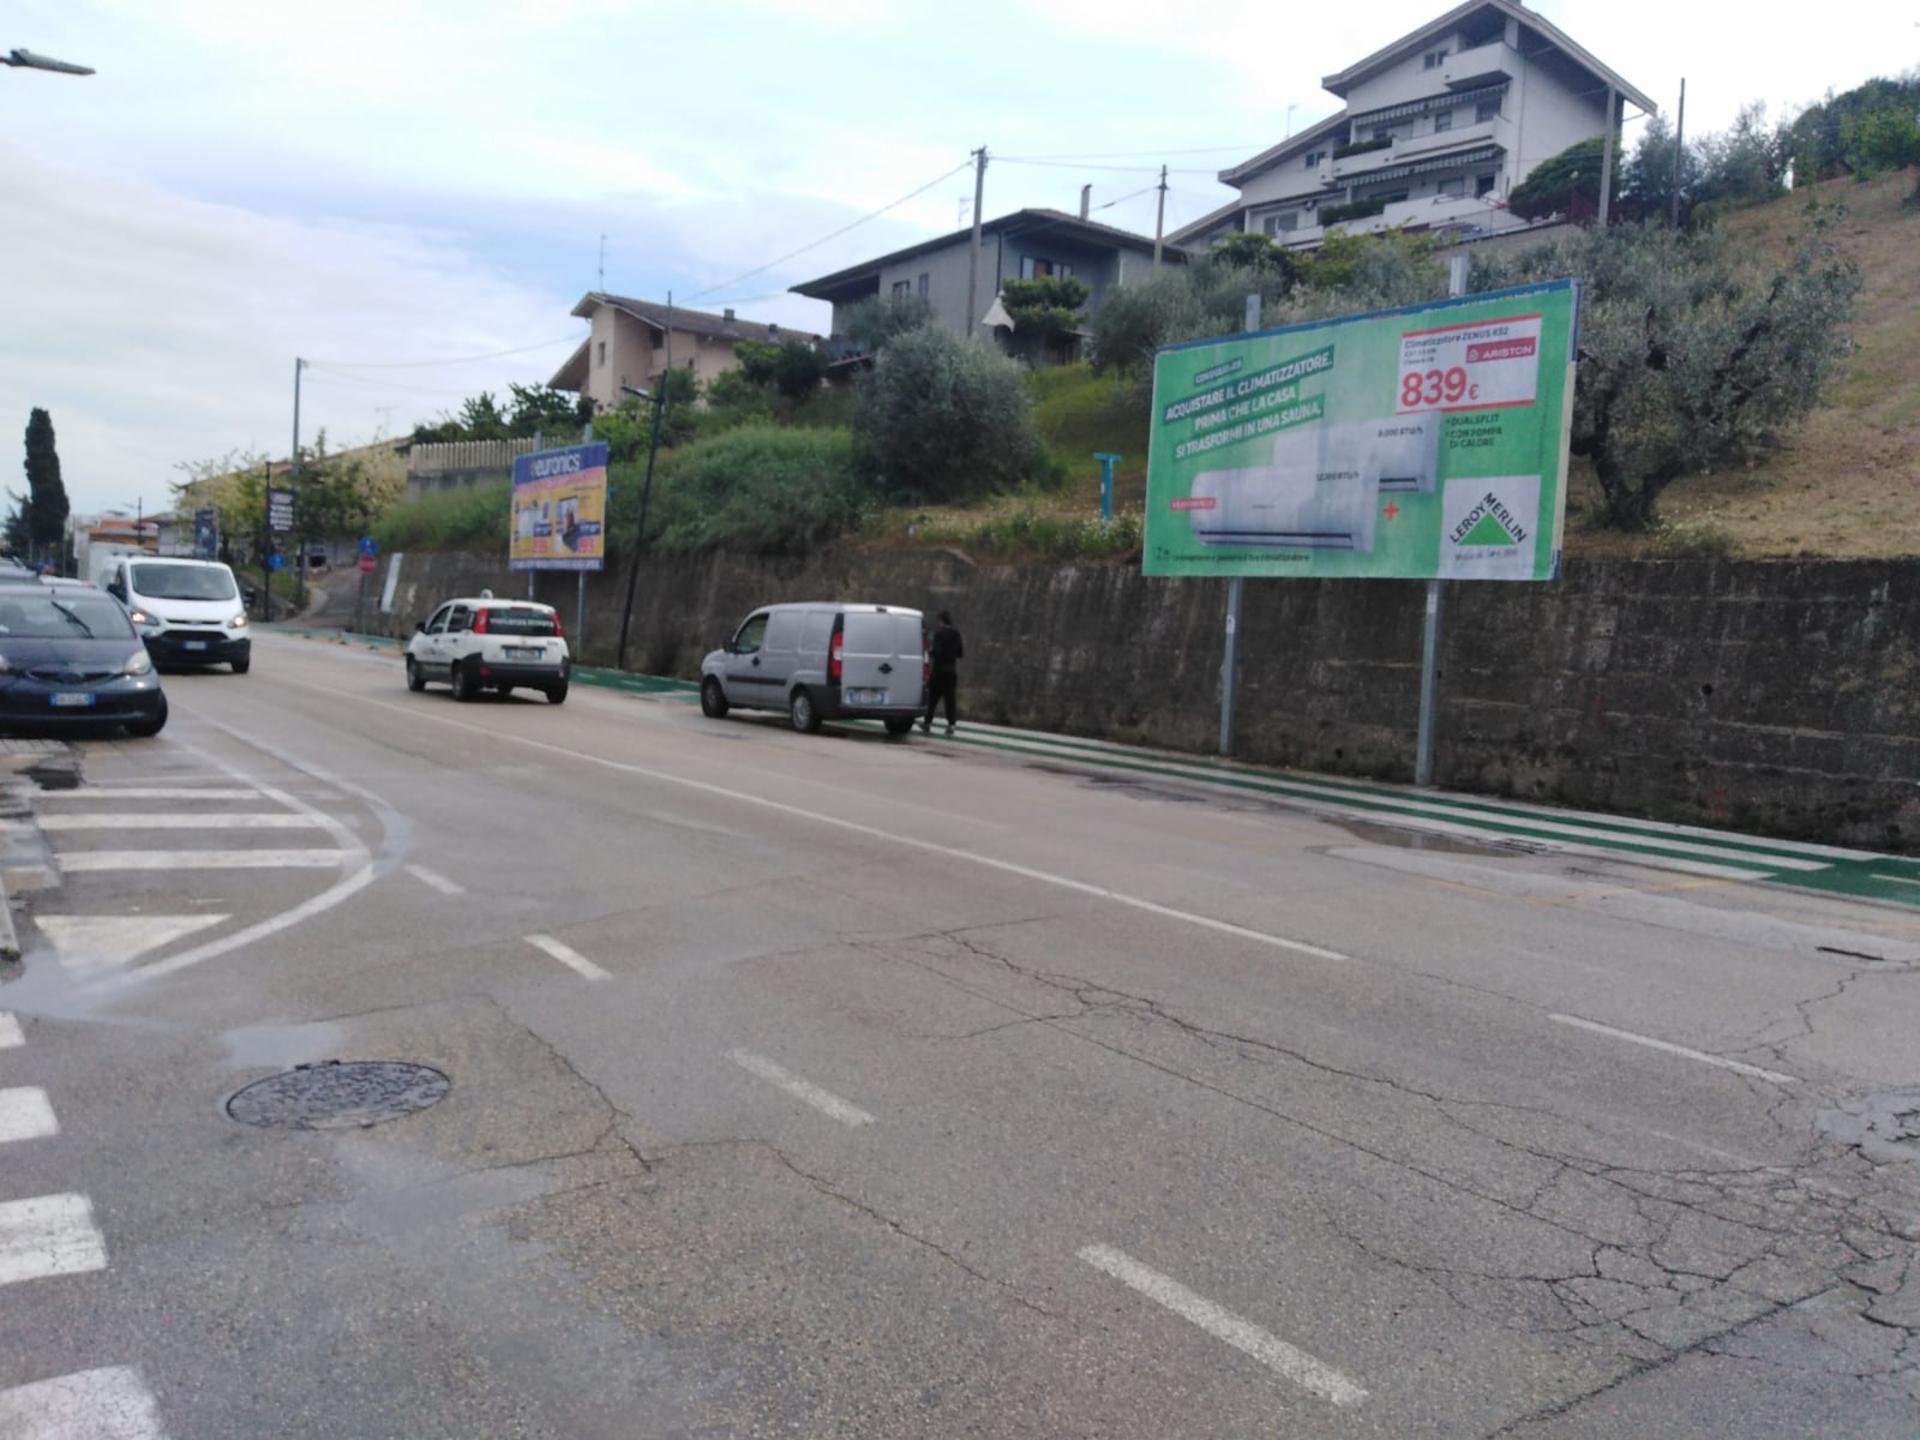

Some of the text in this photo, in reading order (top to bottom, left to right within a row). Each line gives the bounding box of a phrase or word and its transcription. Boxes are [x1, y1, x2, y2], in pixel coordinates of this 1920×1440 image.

[1482, 346, 1532, 359] ARISTON
[1165, 389, 1224, 420] ACQUISTARE
[1226, 386, 1236, 400] IL
[1195, 386, 1296, 431] PRIMA CHE LA CASA
[1187, 427, 1243, 457] TRASFORMI
[1244, 422, 1257, 438] IN
[1258, 414, 1280, 434] UNA
[1449, 492, 1528, 544] LEROY MERLIN
